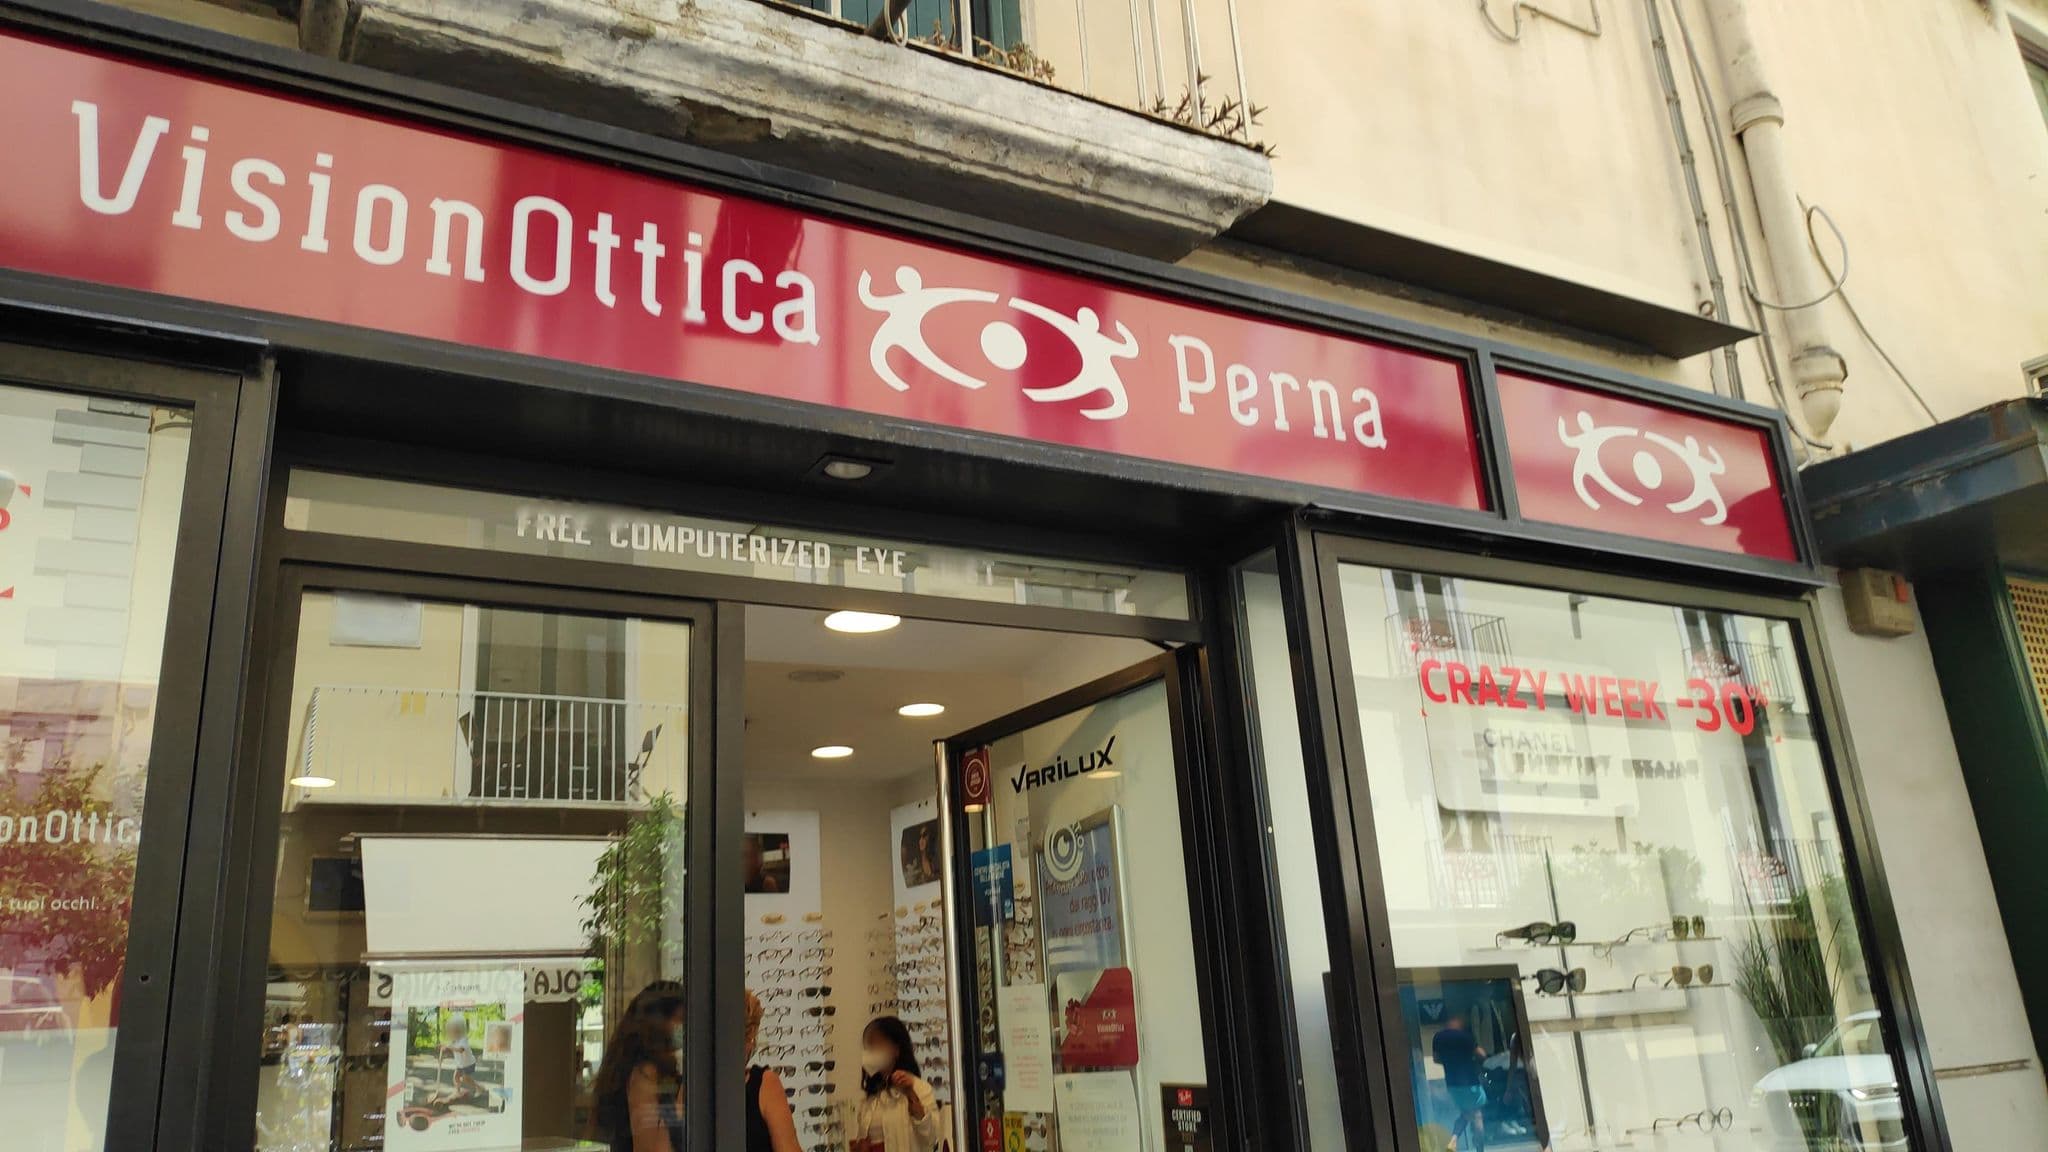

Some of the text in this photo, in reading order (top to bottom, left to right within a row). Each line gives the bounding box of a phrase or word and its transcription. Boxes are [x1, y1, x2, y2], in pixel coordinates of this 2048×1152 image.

[71, 100, 1387, 450] VisionOttica Perna
[610, 518, 831, 569] COMPUTERIZED
[856, 546, 906, 578] EYE
[1420, 659, 1547, 712] CRAZY
[1560, 672, 1666, 721] WEEK
[1483, 727, 1576, 754] CHANEL
[0, 809, 142, 844] onOttic
